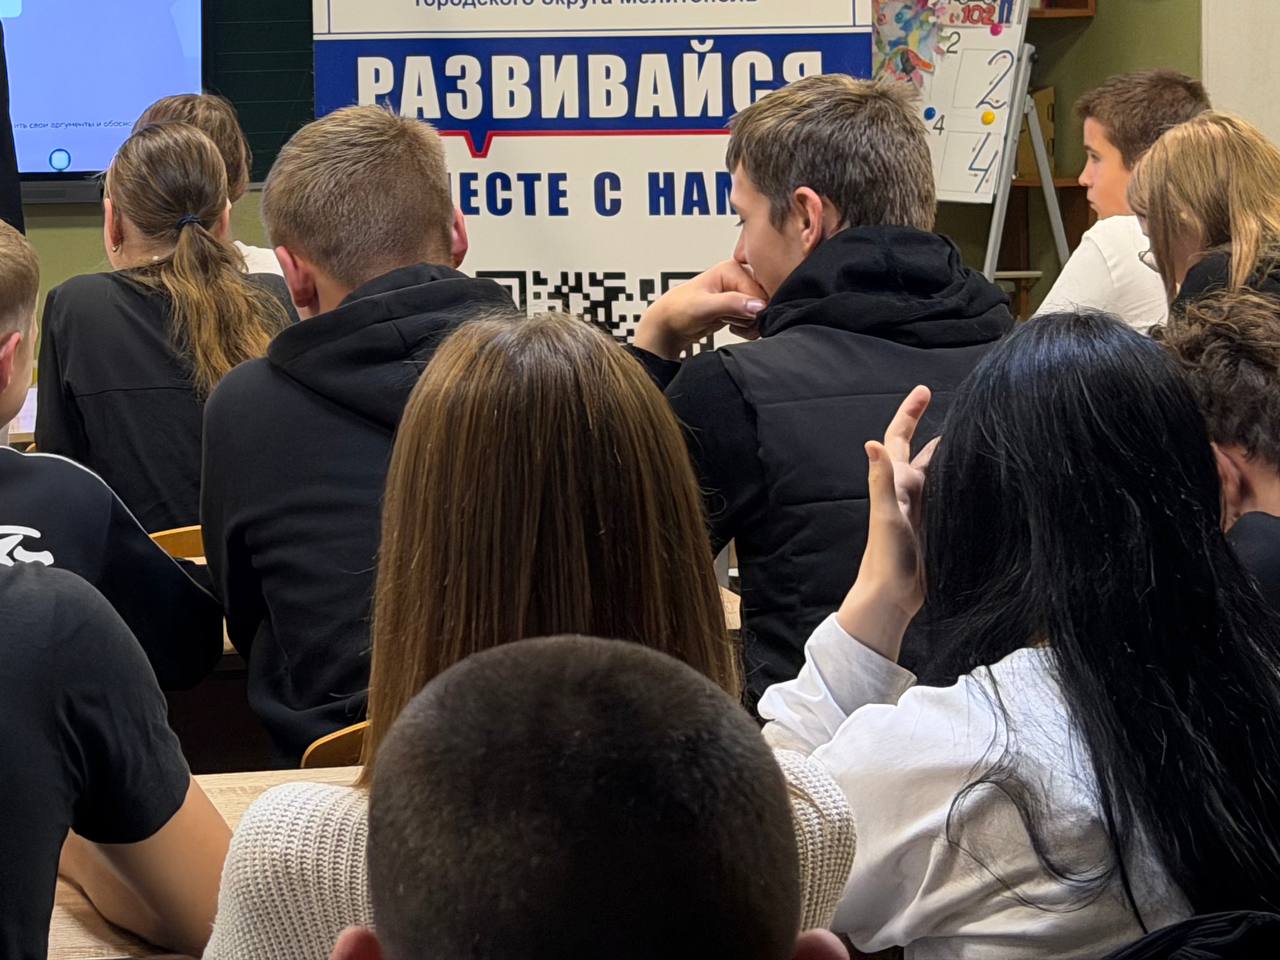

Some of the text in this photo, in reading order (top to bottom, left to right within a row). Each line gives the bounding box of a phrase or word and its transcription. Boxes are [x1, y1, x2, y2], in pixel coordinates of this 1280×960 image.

[961, 4, 996, 26] 102
[946, 31, 961, 54] 2
[975, 49, 1015, 110] 2
[932, 114, 945, 136] 4
[968, 132, 999, 193] 4
[448, 171, 570, 216] ЕСТЕ
[593, 171, 622, 217] С
